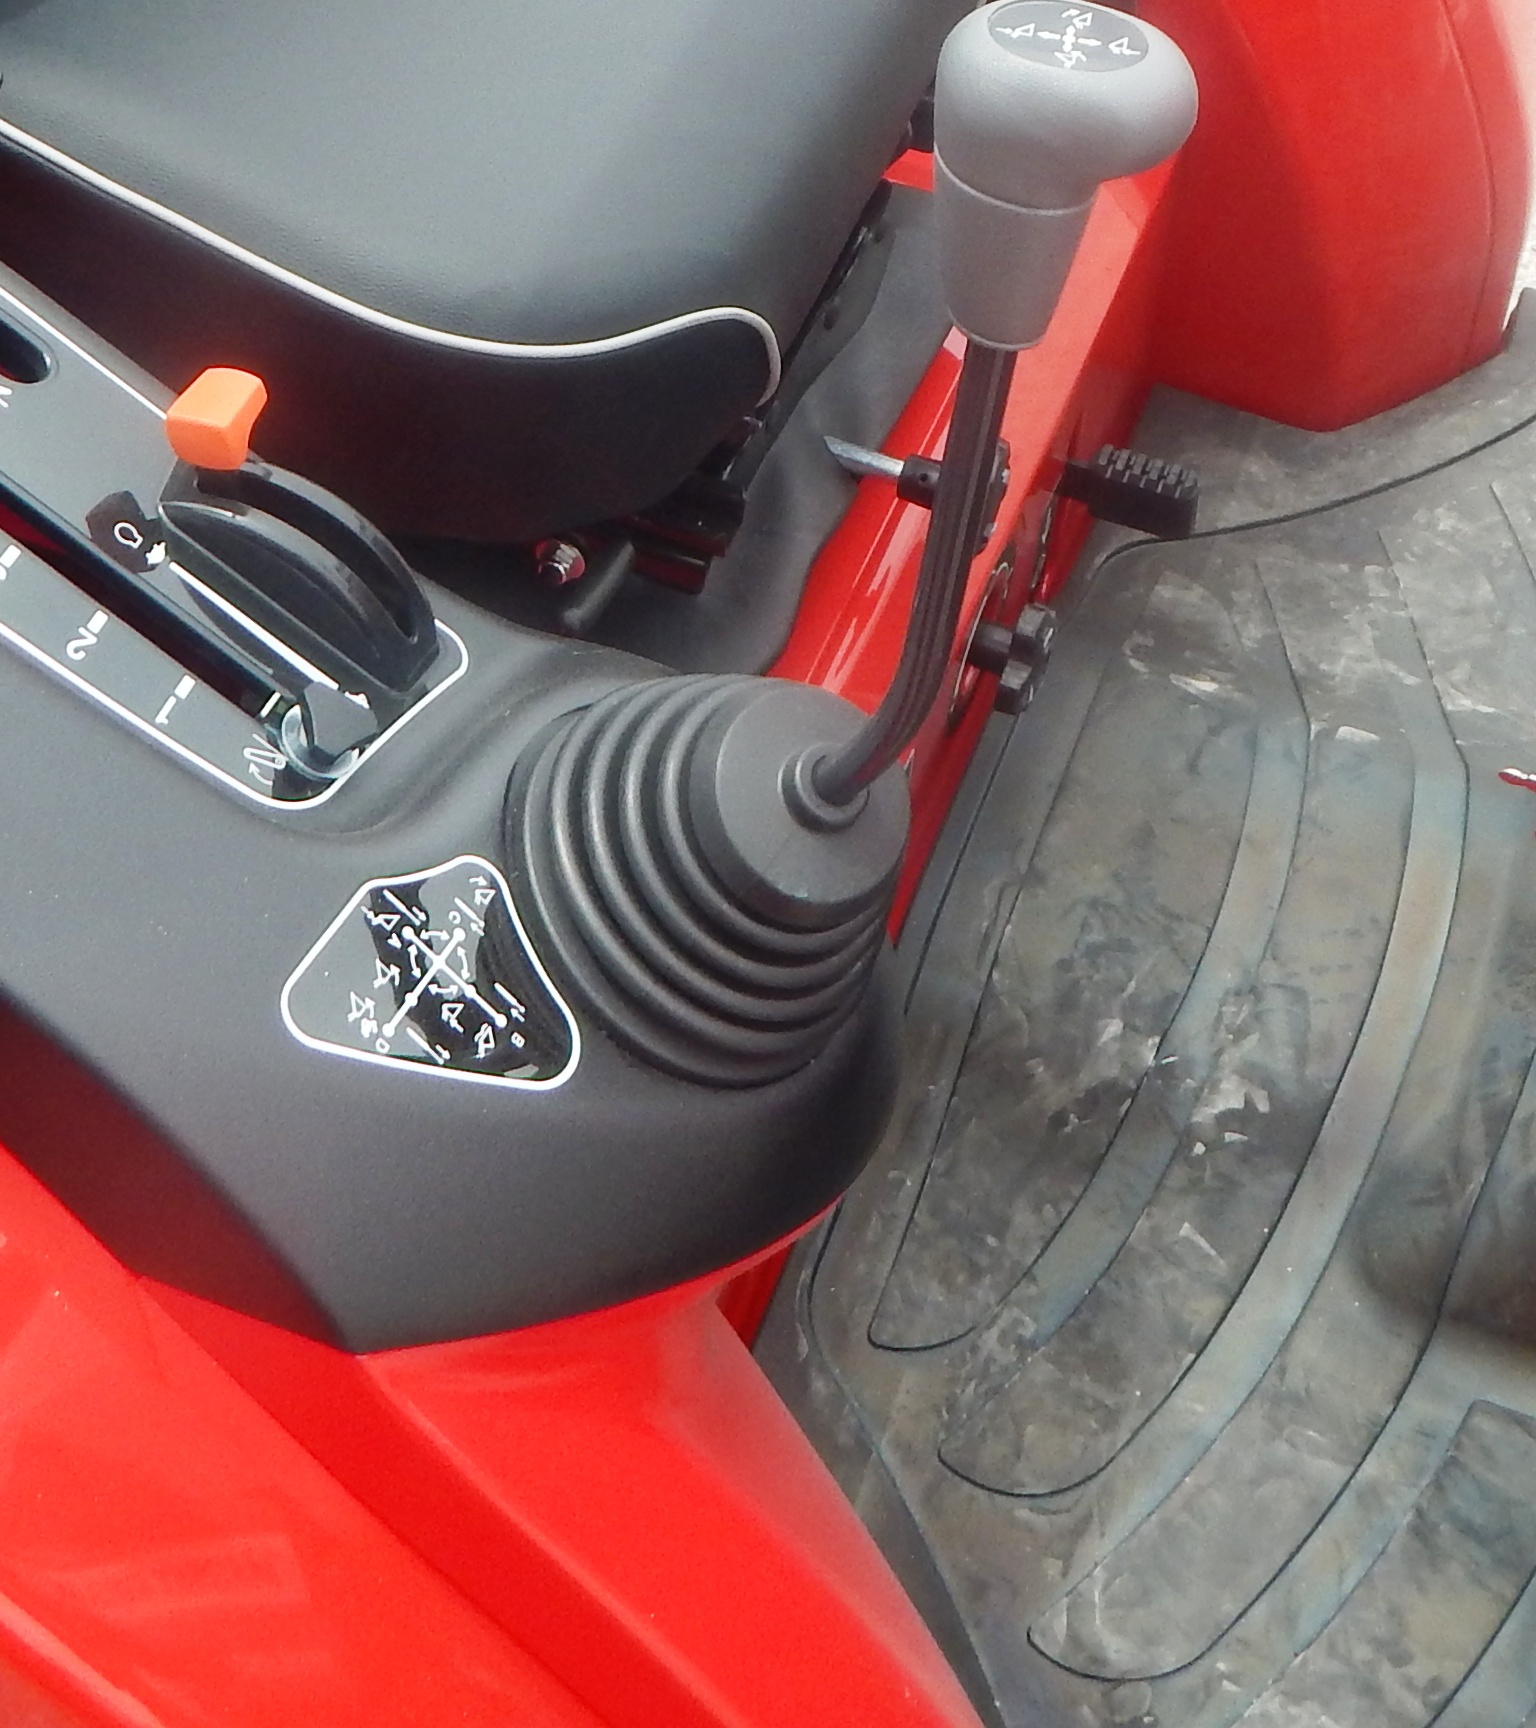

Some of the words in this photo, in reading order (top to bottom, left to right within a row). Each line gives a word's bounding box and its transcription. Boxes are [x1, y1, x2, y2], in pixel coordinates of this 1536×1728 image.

[66, 626, 98, 660] 2
[155, 695, 177, 725] 1
[510, 1031, 526, 1049] B
